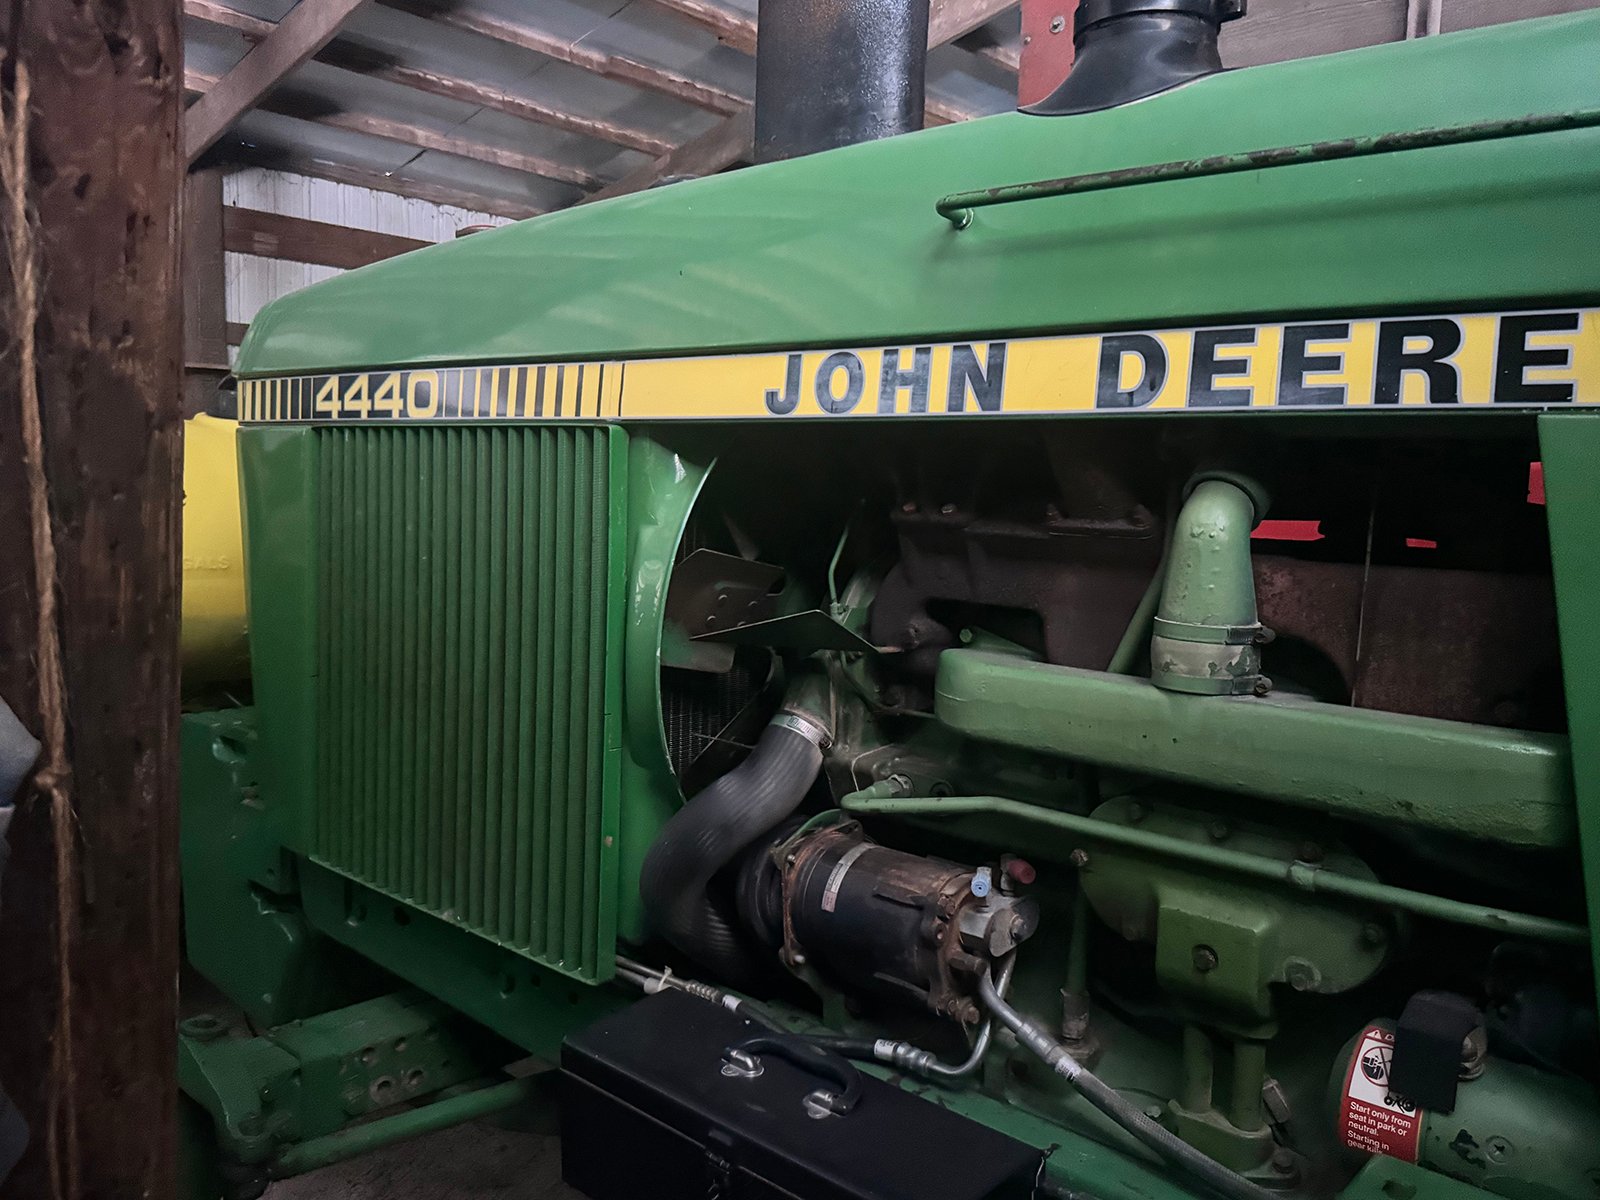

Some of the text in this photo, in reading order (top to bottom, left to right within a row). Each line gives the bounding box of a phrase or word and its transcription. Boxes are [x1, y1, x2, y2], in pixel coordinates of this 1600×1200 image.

[764, 312, 1581, 416] JOHN DEERE
[315, 370, 440, 419] 4440
[1349, 1112, 1408, 1136] seat in park or
[1350, 1101, 1411, 1128] Start only from
[1348, 1120, 1379, 1136] neutral.
[1347, 1130, 1390, 1151] Starting in
[1347, 1139, 1366, 1150] gear
